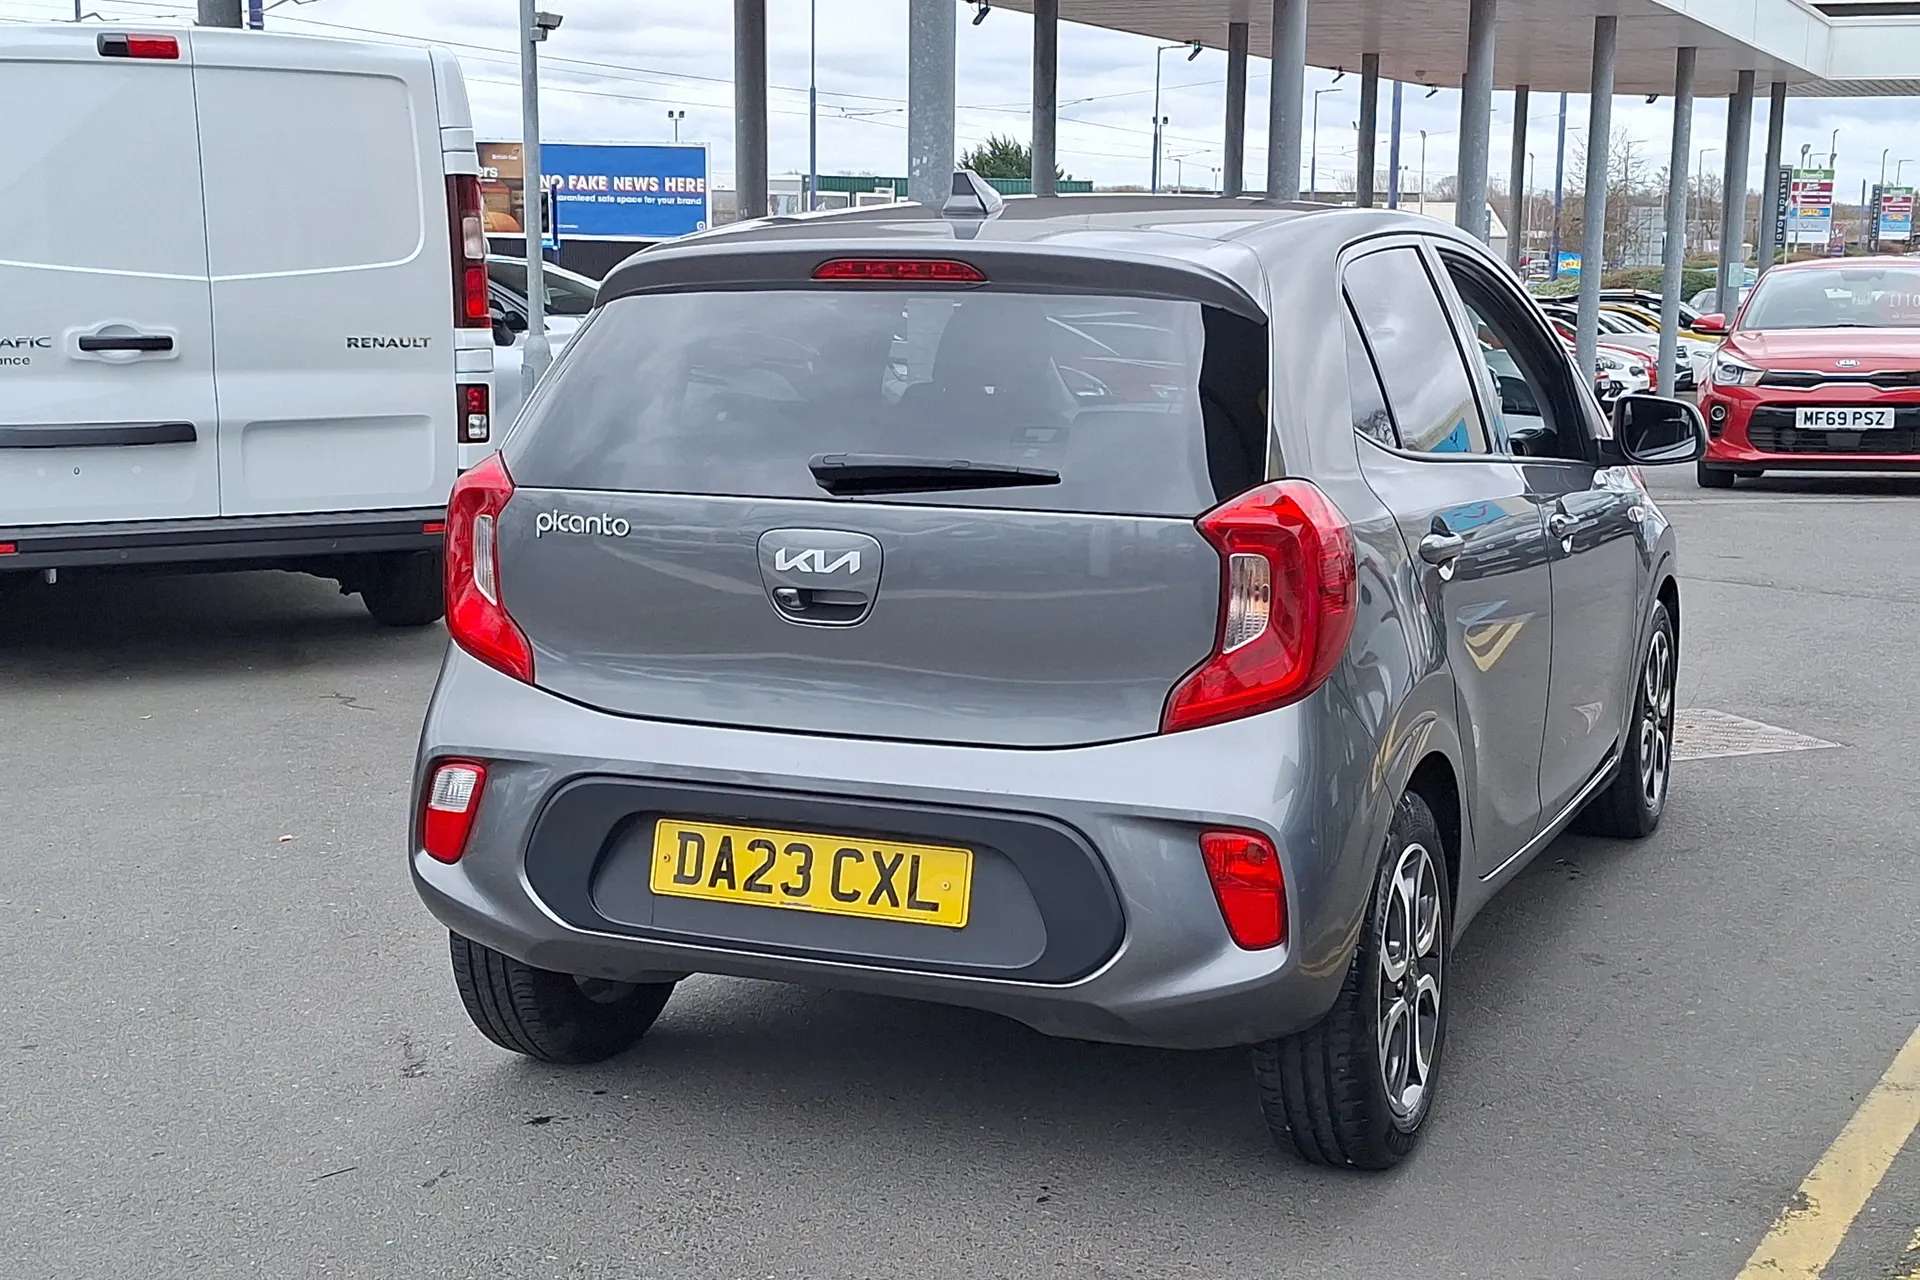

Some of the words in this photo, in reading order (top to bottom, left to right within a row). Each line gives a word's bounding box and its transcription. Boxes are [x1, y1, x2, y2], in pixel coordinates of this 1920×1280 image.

[541, 174, 565, 191] NO
[568, 175, 609, 191] FAKE
[613, 176, 660, 192] NEWS
[664, 177, 705, 193] HERE
[598, 194, 615, 203] safe
[617, 195, 643, 205] space
[644, 195, 656, 204] for
[657, 196, 676, 206] your
[677, 196, 703, 206] brand
[345, 336, 432, 349] RENAULT
[1803, 411, 1848, 426] MF69
[1852, 411, 1886, 426] PSZ
[535, 508, 632, 539] picanto
[774, 547, 861, 576] KIA
[672, 830, 815, 898] DA23
[831, 848, 941, 913] CXL
